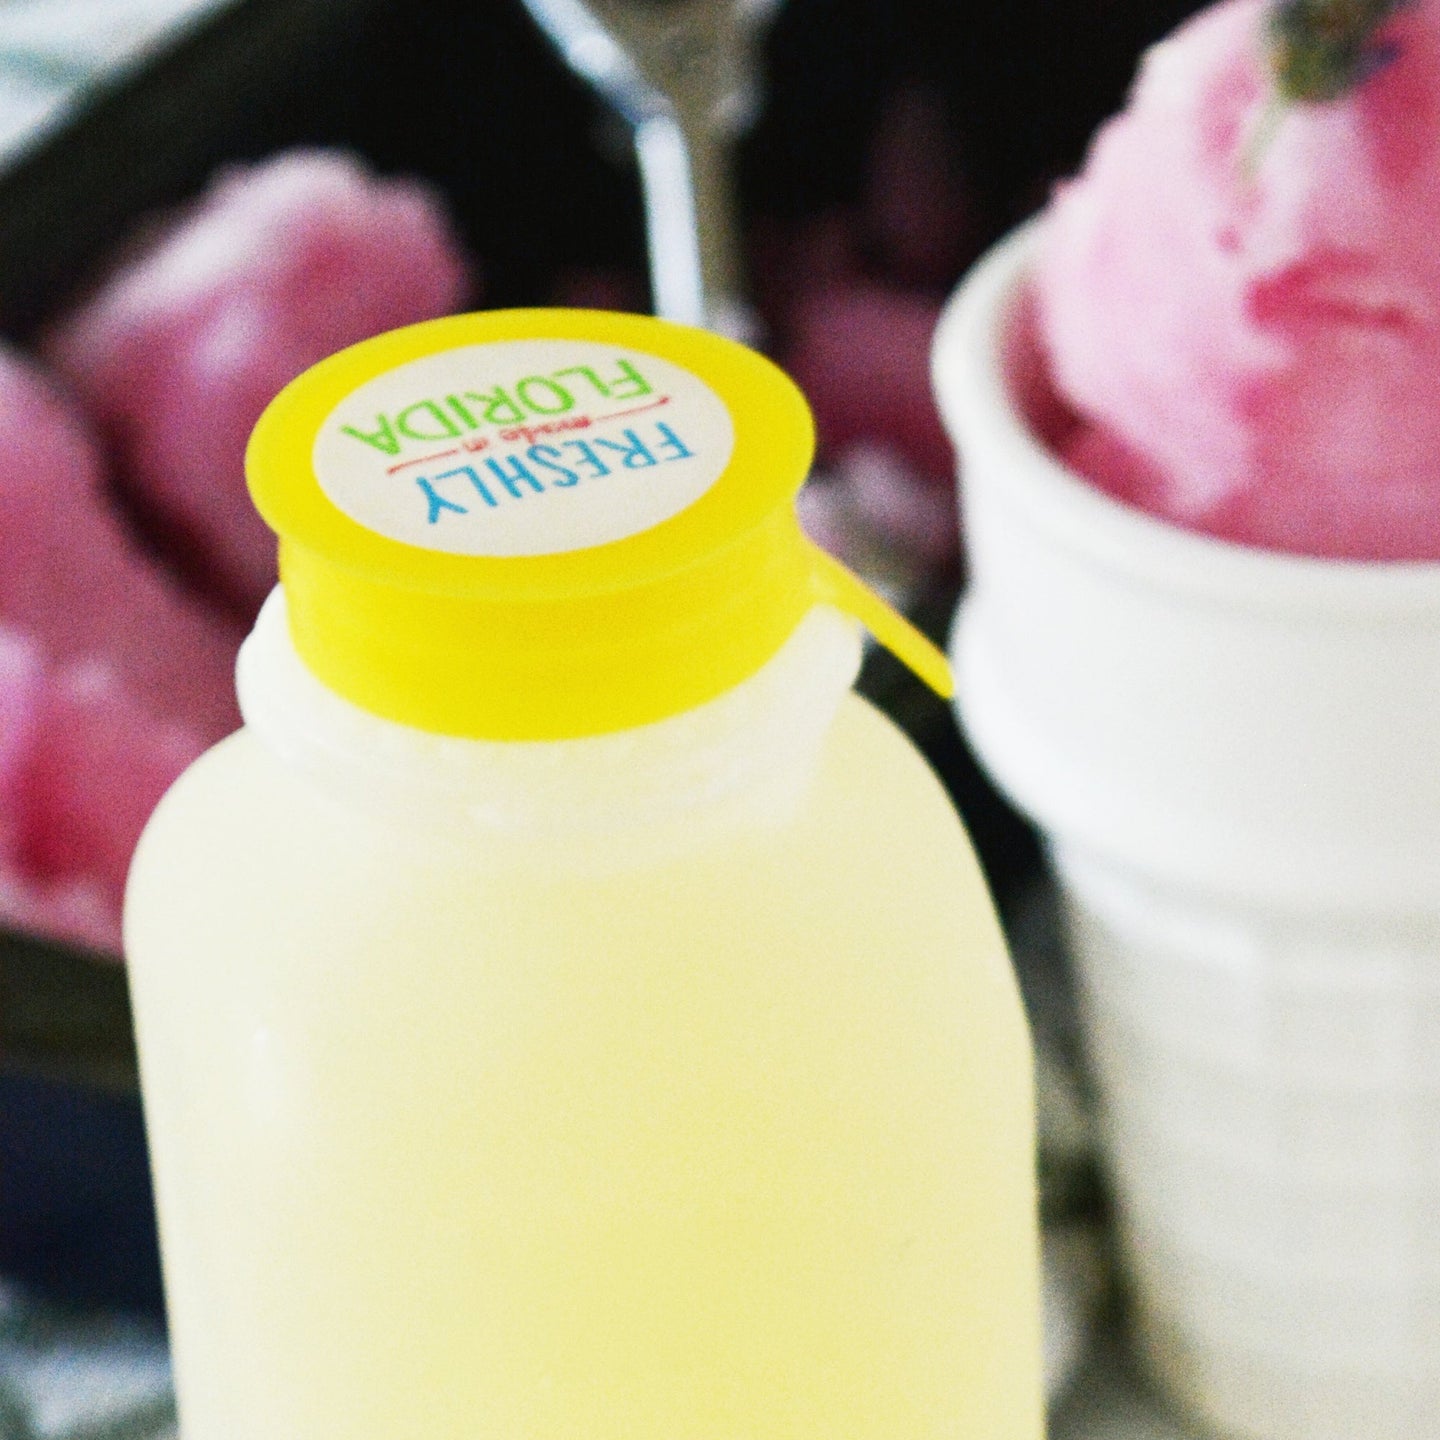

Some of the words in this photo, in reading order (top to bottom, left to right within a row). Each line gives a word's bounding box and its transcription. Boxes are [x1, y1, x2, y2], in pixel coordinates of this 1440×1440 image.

[339, 358, 655, 457] FLORIDA
[499, 414, 594, 446] made
[415, 420, 696, 526] FRESHLY
[462, 435, 490, 454] in
